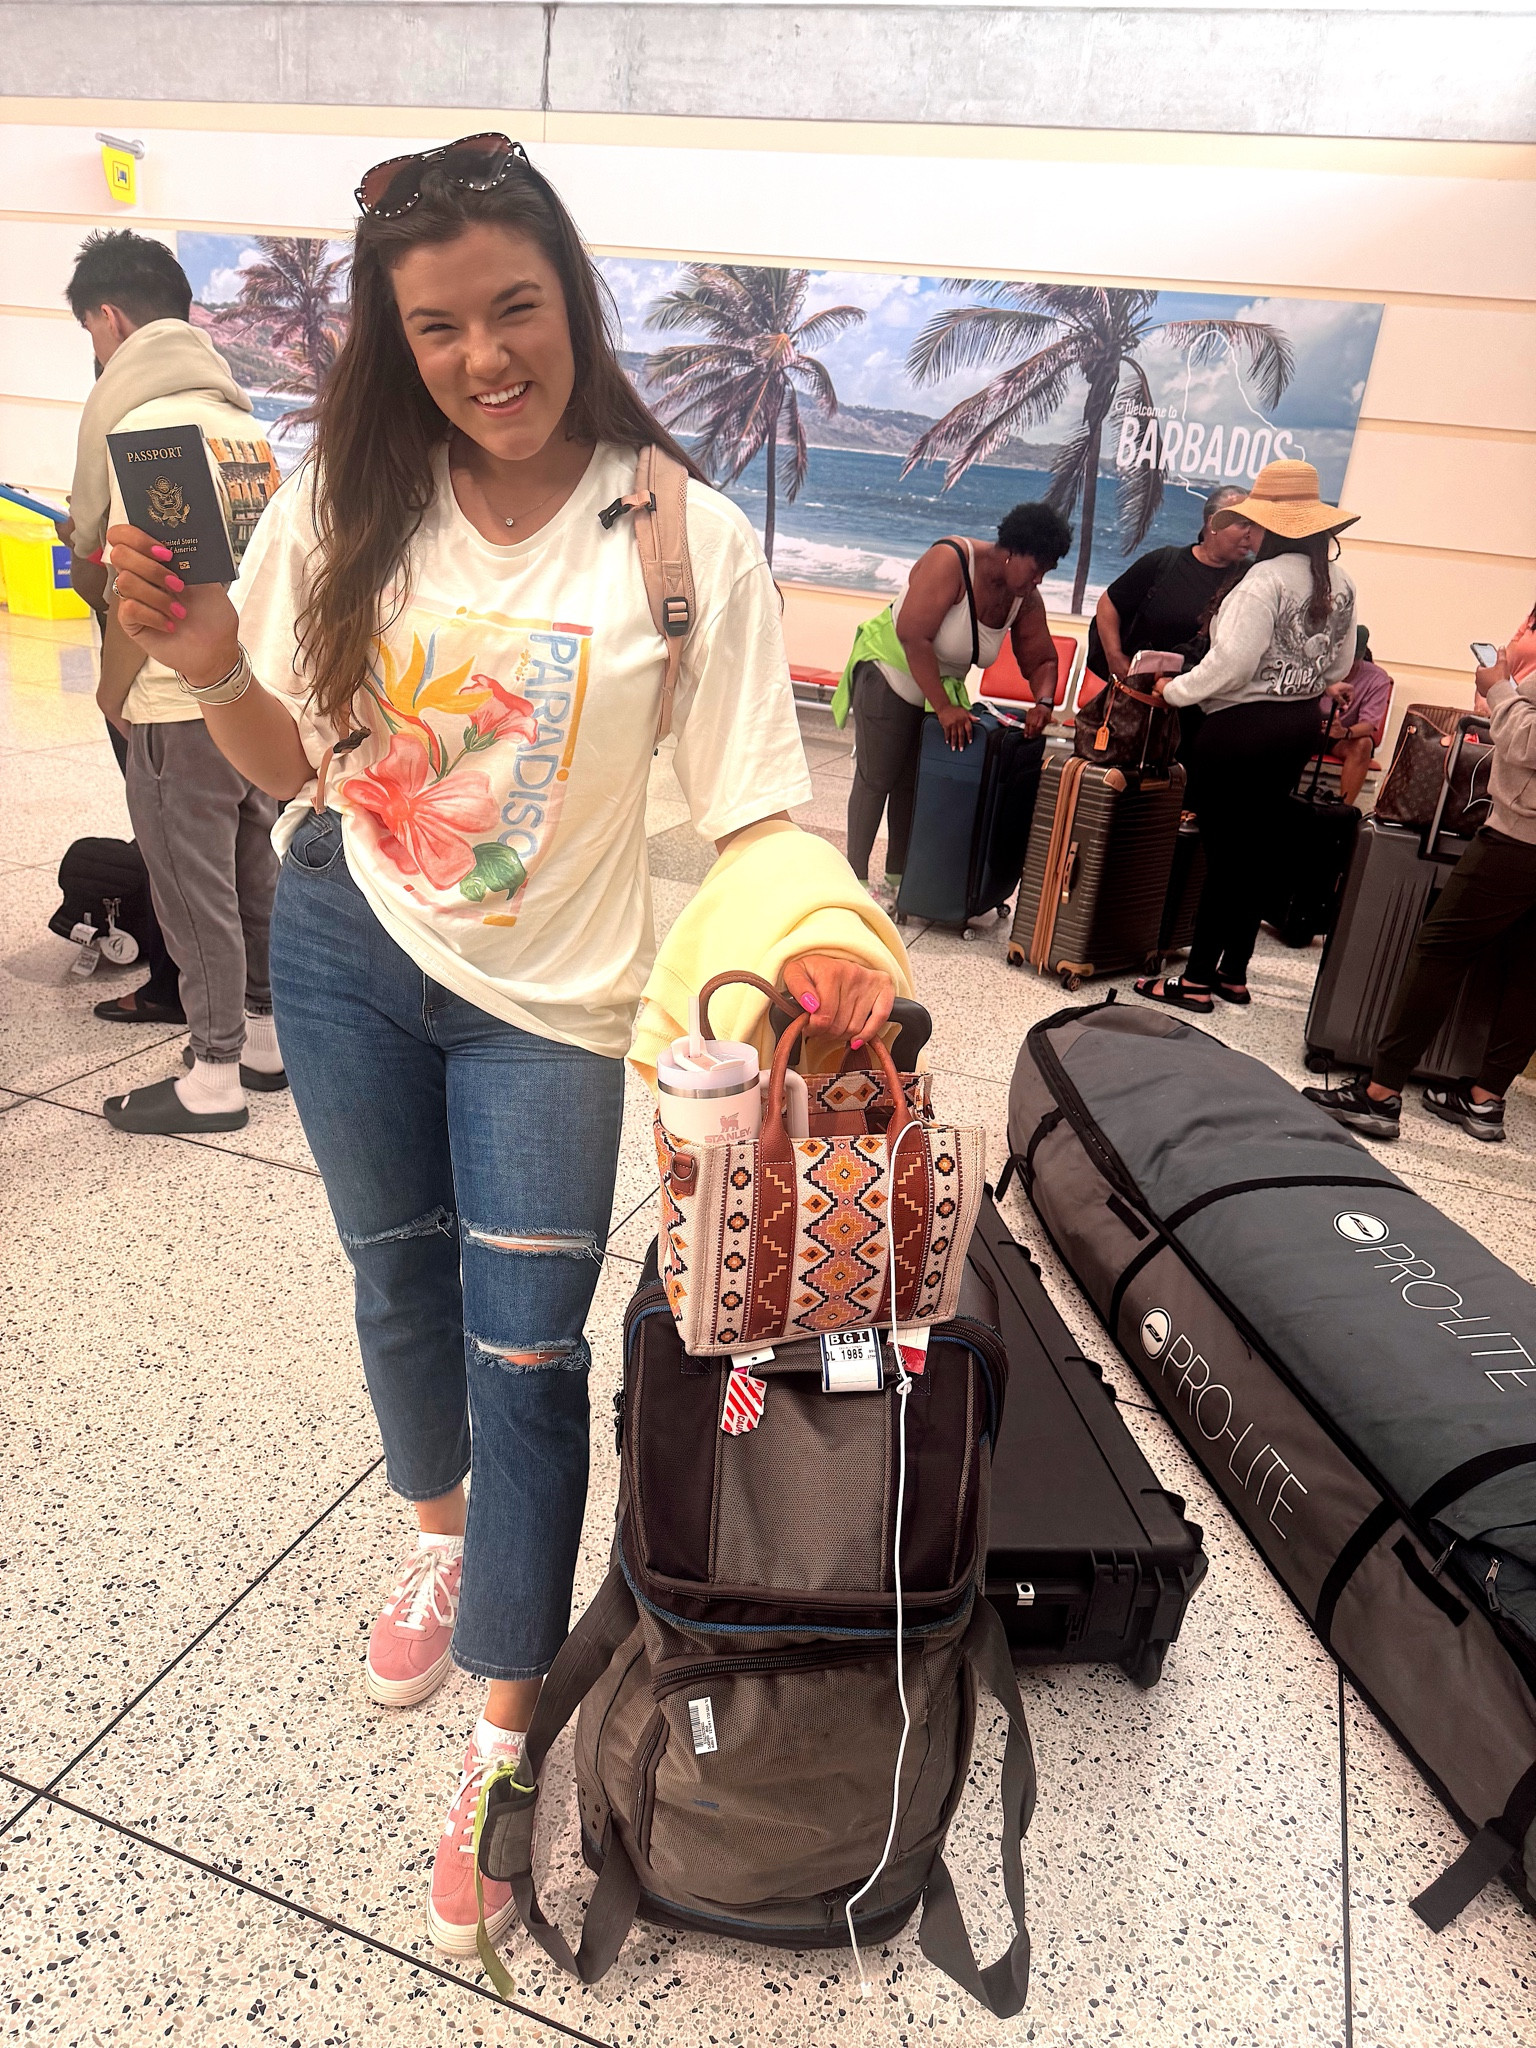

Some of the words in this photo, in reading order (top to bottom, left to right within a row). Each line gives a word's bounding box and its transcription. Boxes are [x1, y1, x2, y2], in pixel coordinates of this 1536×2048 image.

[1115, 398, 1167, 418] Welcome
[1168, 404, 1178, 419] to
[127, 446, 183, 463] PASSPORT
[1116, 416, 1293, 480] BARBADOS
[173, 545, 197, 554] America
[181, 537, 198, 545] States
[497, 633, 579, 859] PARADISO
[704, 1126, 751, 1144] STANLEY
[1355, 1242, 1536, 1393] PRO-LITE
[829, 1331, 867, 1346] BGI
[841, 1348, 864, 1360] 1985
[1161, 1333, 1309, 1541] PRO-LITE
